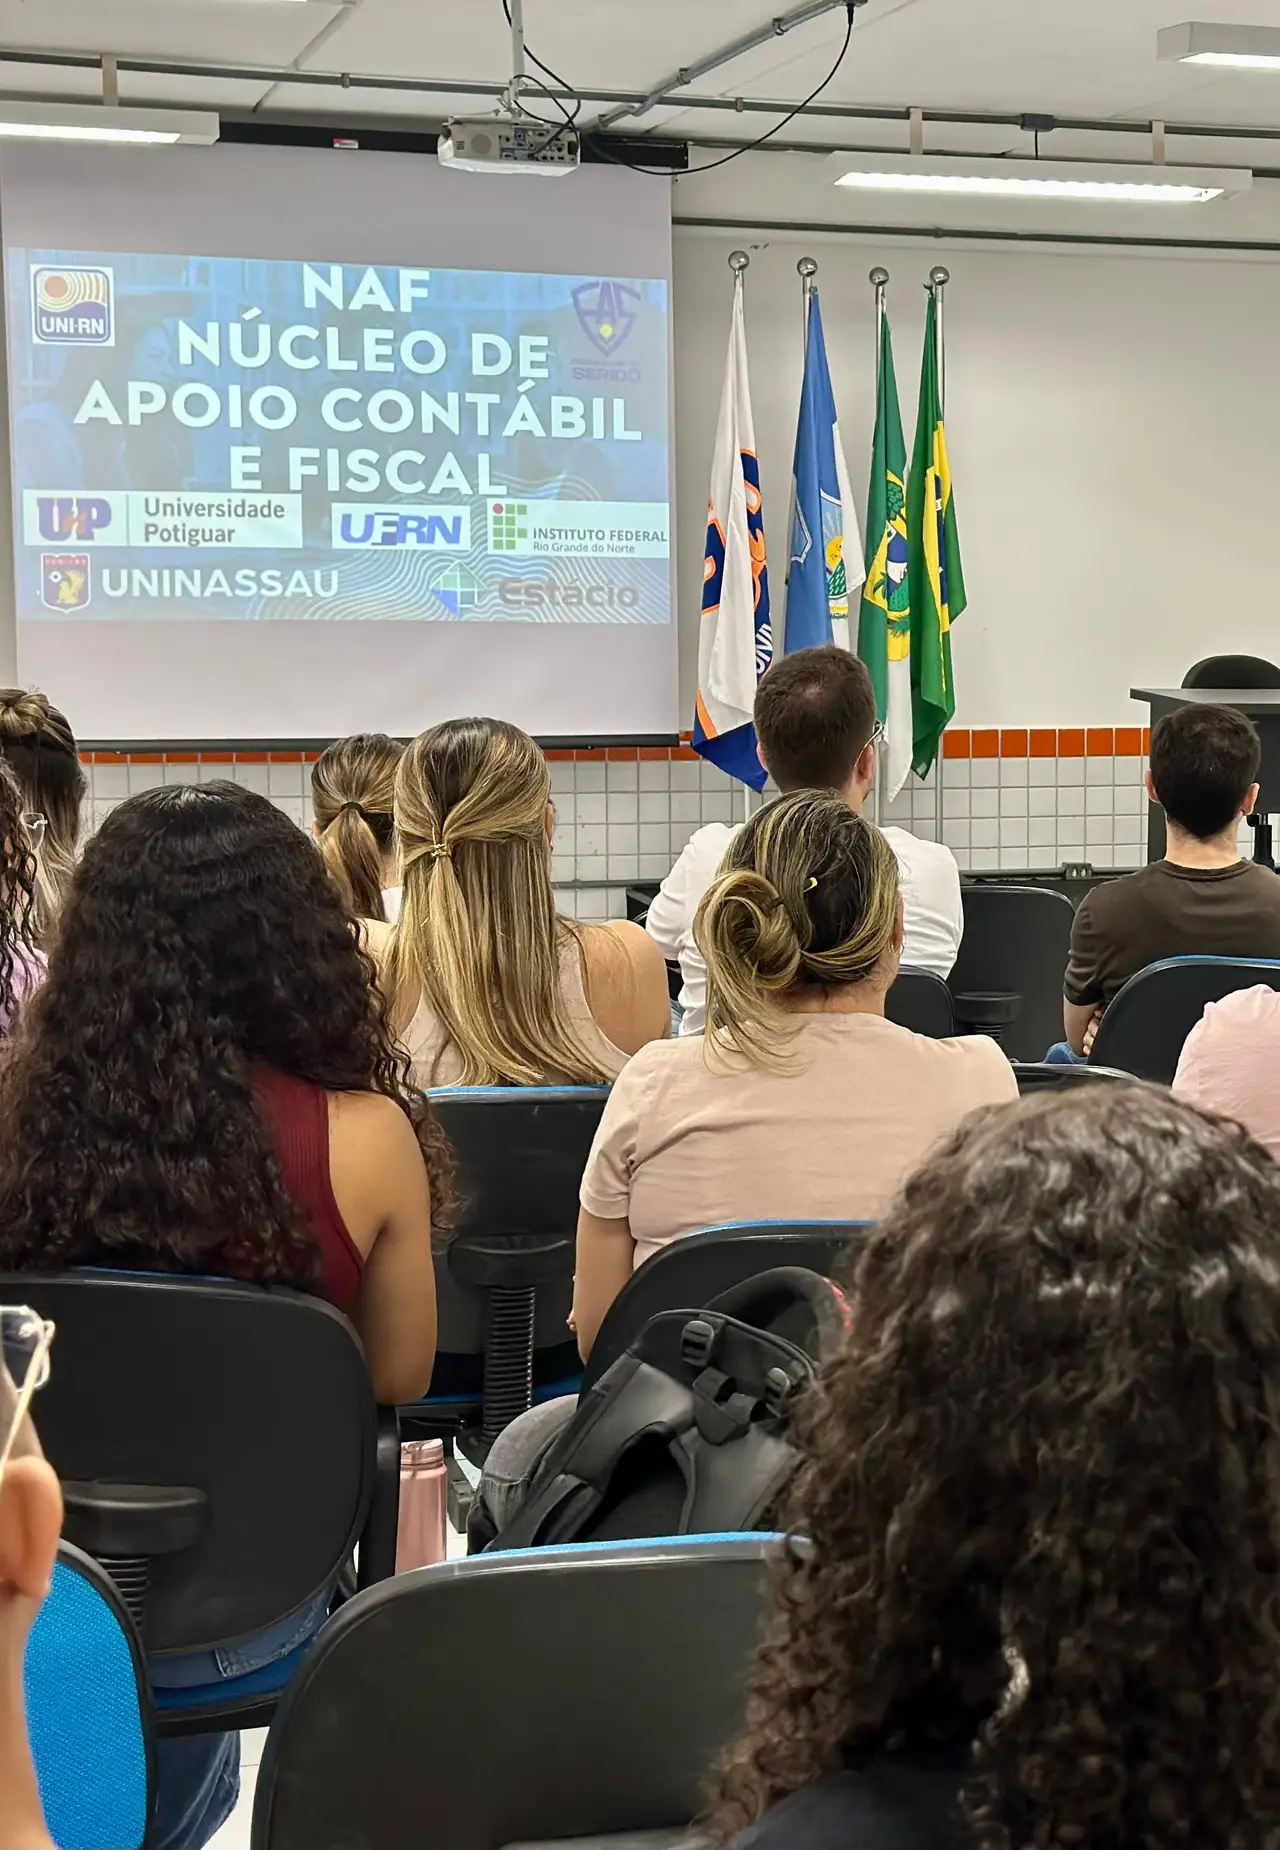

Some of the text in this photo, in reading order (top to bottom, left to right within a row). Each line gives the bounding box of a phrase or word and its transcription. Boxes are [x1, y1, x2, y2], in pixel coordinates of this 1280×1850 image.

[303, 264, 431, 312] NAF
[178, 306, 549, 379] NÚCLEO DE
[74, 379, 642, 441] APOIO CONTÁBIL
[229, 445, 508, 496] E FISCAL
[144, 497, 285, 518] Universidade
[144, 523, 236, 547] Potiguar
[341, 512, 462, 546] UFRN
[533, 528, 668, 542] INSTITUTO FEDERAL
[533, 541, 635, 554] Rio Grande do Norte
[101, 568, 339, 598] UNINASSAU
